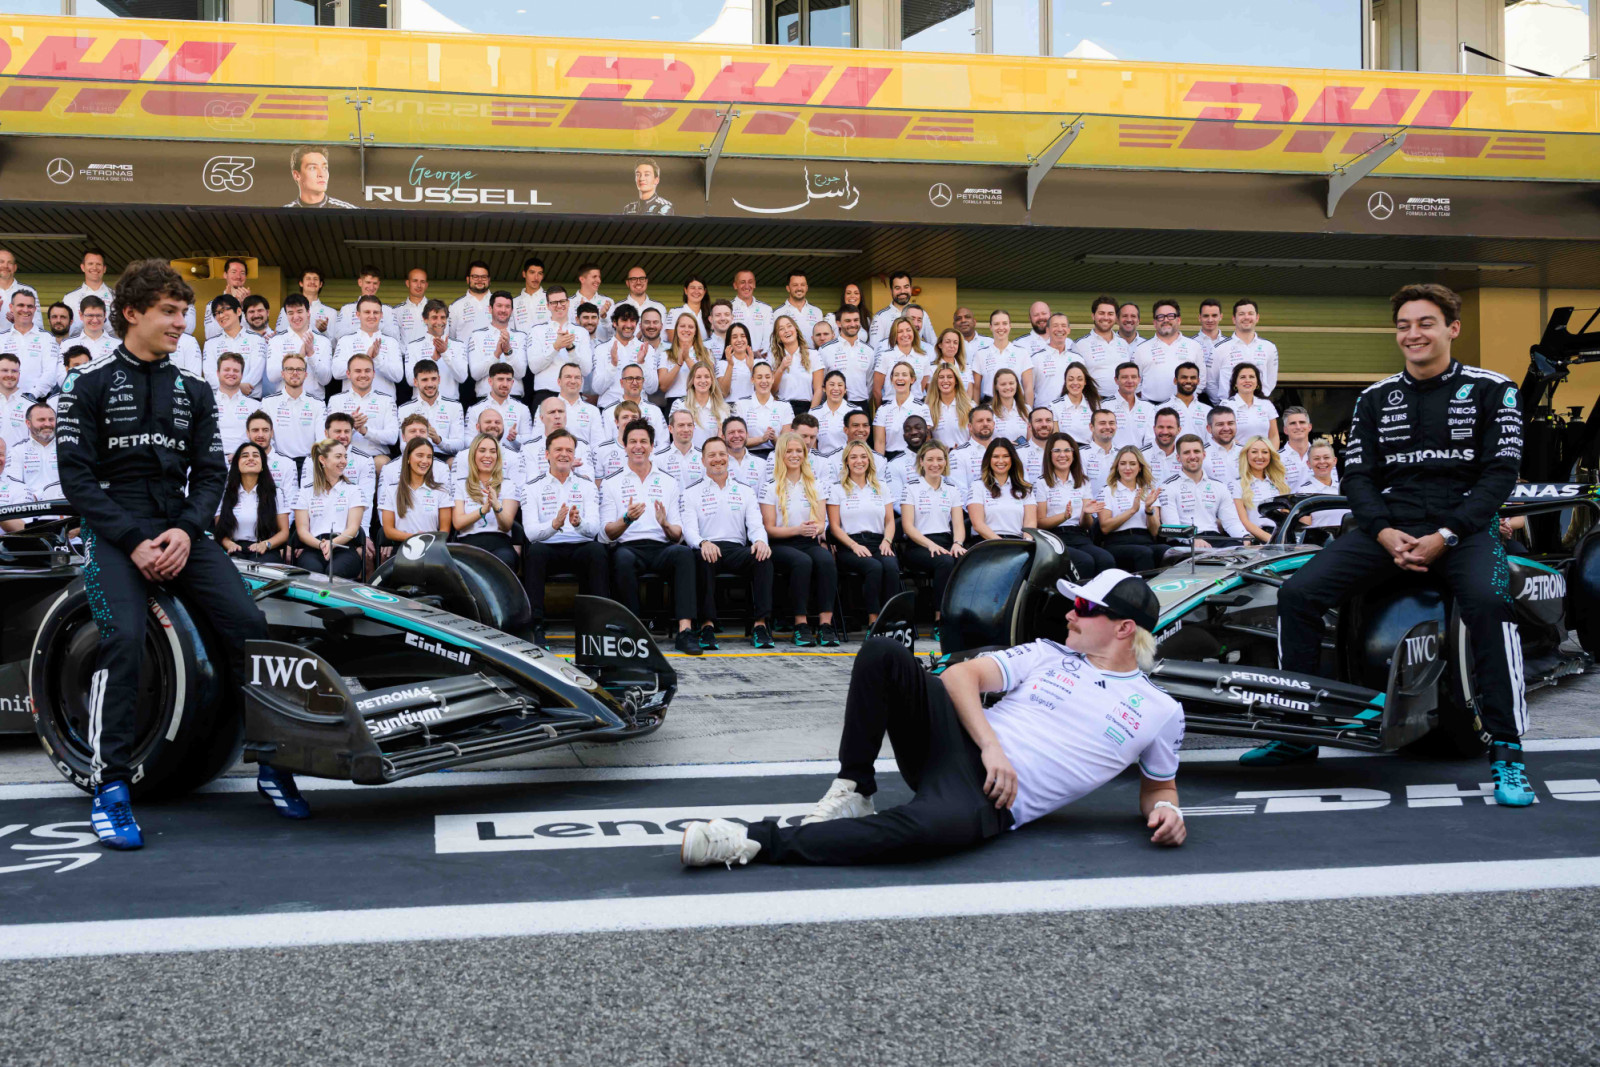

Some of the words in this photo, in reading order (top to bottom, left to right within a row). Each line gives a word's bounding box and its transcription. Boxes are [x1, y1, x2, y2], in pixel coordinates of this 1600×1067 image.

[0, 36, 259, 119] HL
[559, 56, 913, 139] DHL
[1178, 81, 1491, 159] DHL
[80, 169, 134, 177] PETRONAS
[203, 155, 255, 192] 63
[409, 154, 477, 204] George
[365, 185, 553, 206] RUSSELL
[1399, 203, 1451, 211] PETRONAS
[118, 394, 134, 402] UBS
[1391, 413, 1408, 421] UBS
[1448, 407, 1477, 415] INEOS
[1502, 425, 1520, 434] IWC
[108, 433, 186, 452] PETRONAS
[1385, 449, 1475, 465] PETRONAS
[405, 632, 472, 666] Einhell
[581, 634, 650, 659] INEOS
[1405, 633, 1436, 666] IWC
[251, 654, 319, 690] IWC
[1056, 674, 1075, 687] UBS
[1231, 671, 1311, 690] PETRONAS
[357, 686, 431, 711] PETRONAS
[1228, 686, 1310, 712] Syntium
[366, 706, 443, 735] Syntium
[1113, 706, 1141, 731] INEOS
